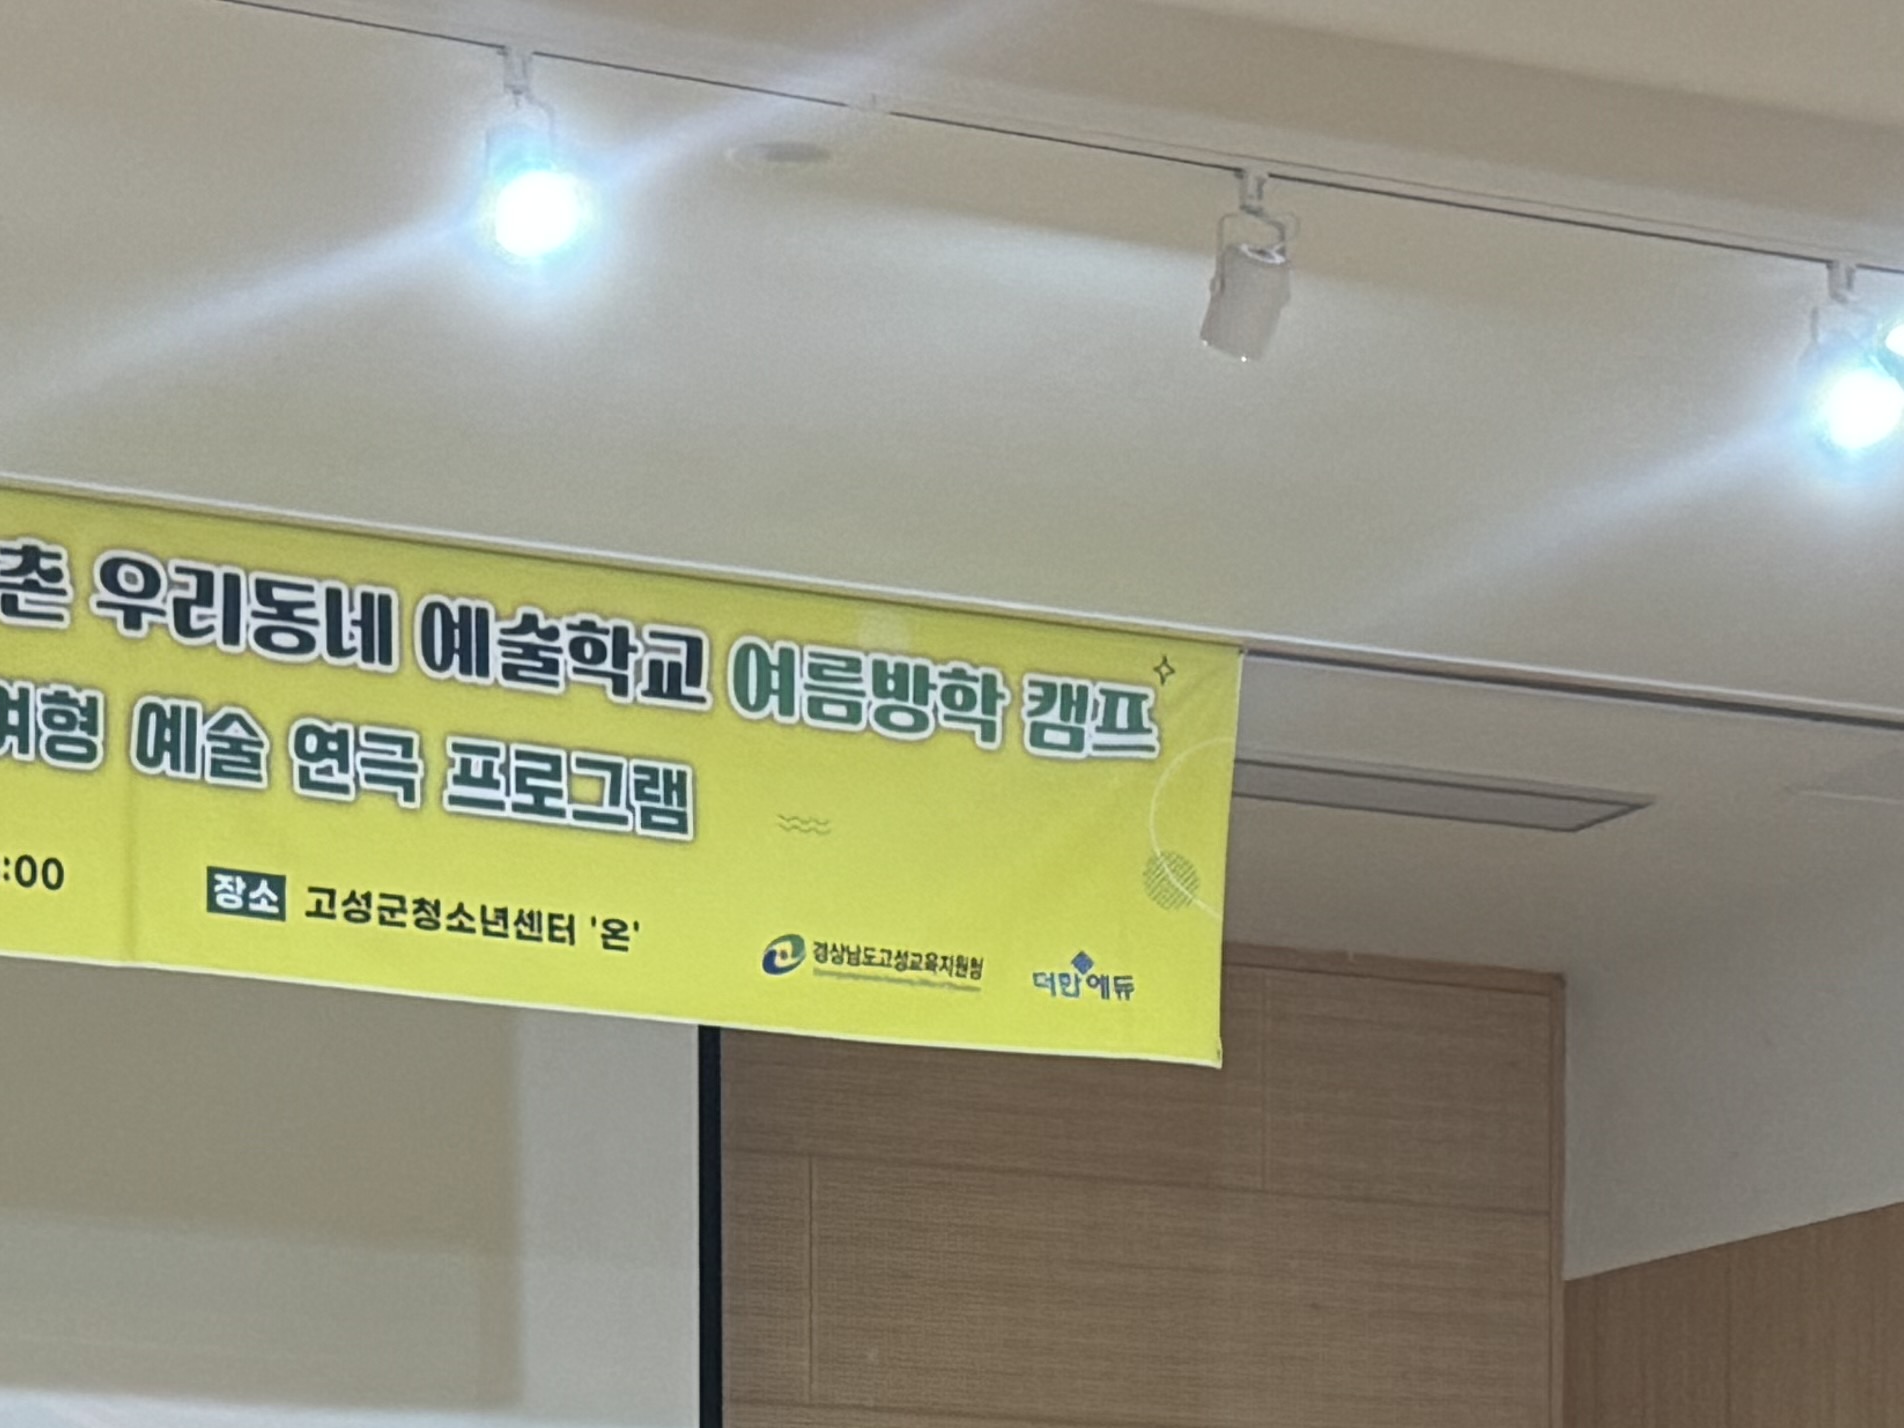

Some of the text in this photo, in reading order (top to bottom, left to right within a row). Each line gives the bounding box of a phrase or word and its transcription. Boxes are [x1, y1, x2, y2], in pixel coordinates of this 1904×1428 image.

[93, 554, 396, 669] 우리동네
[418, 598, 710, 707] 예술학교
[730, 640, 1007, 746] 여름방학
[1022, 679, 1160, 758] 캠프
[133, 699, 267, 785] 예술
[291, 721, 421, 804] 연극
[445, 739, 691, 838] 프로그램
[213, 871, 642, 953] 장소 고성군청소년센터 '온'
